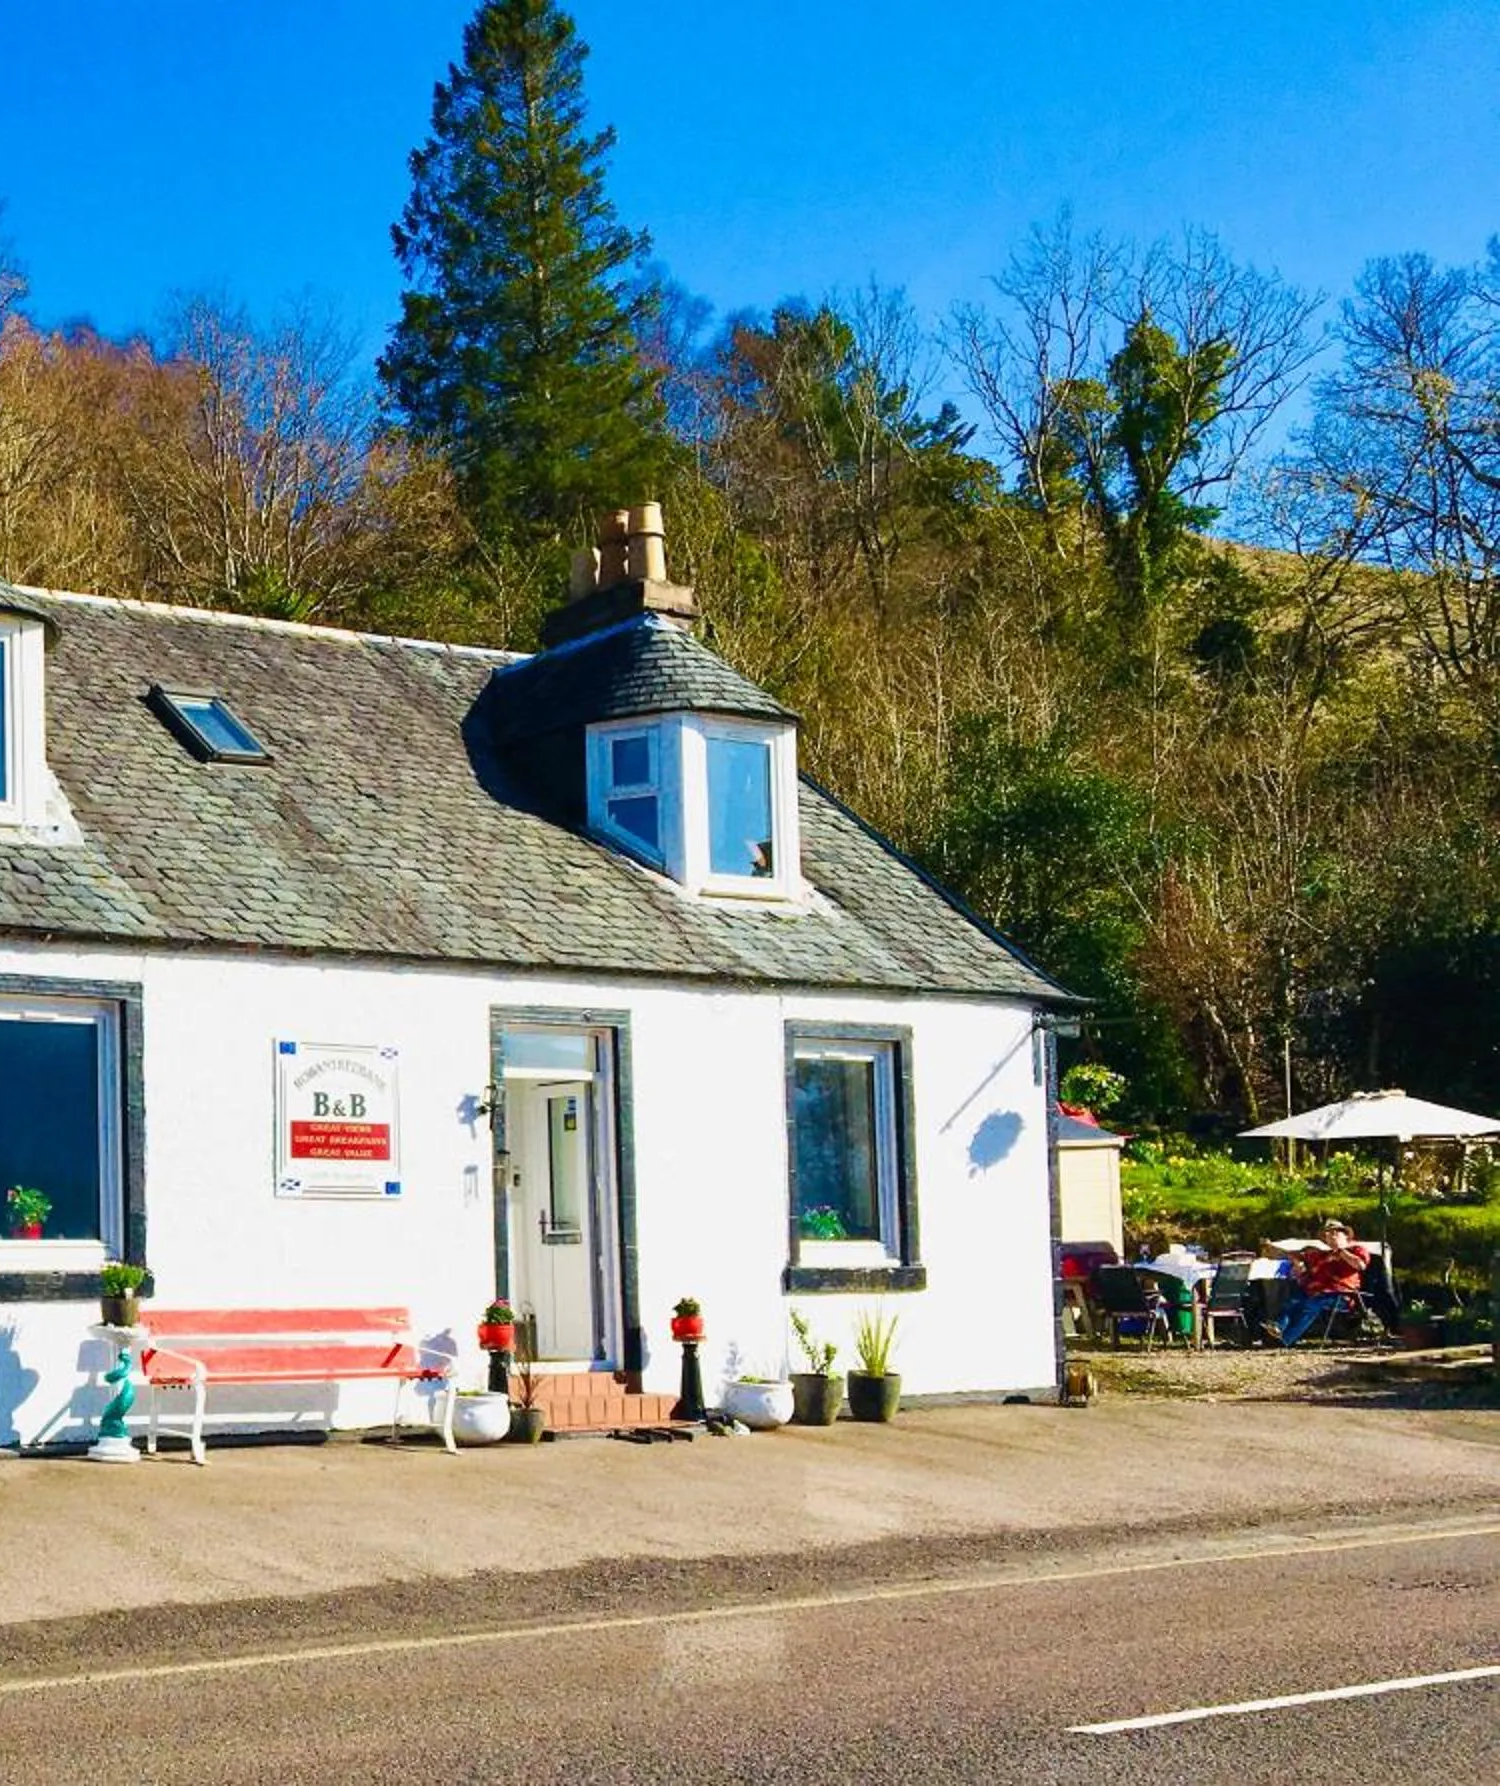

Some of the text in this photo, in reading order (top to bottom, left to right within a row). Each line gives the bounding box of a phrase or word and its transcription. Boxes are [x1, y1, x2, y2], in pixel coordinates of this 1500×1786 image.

[309, 1123, 373, 1134] GREAT VIEWS
[294, 1135, 326, 1144] GREAT
[309, 1147, 373, 1158] GREAT VALUE
